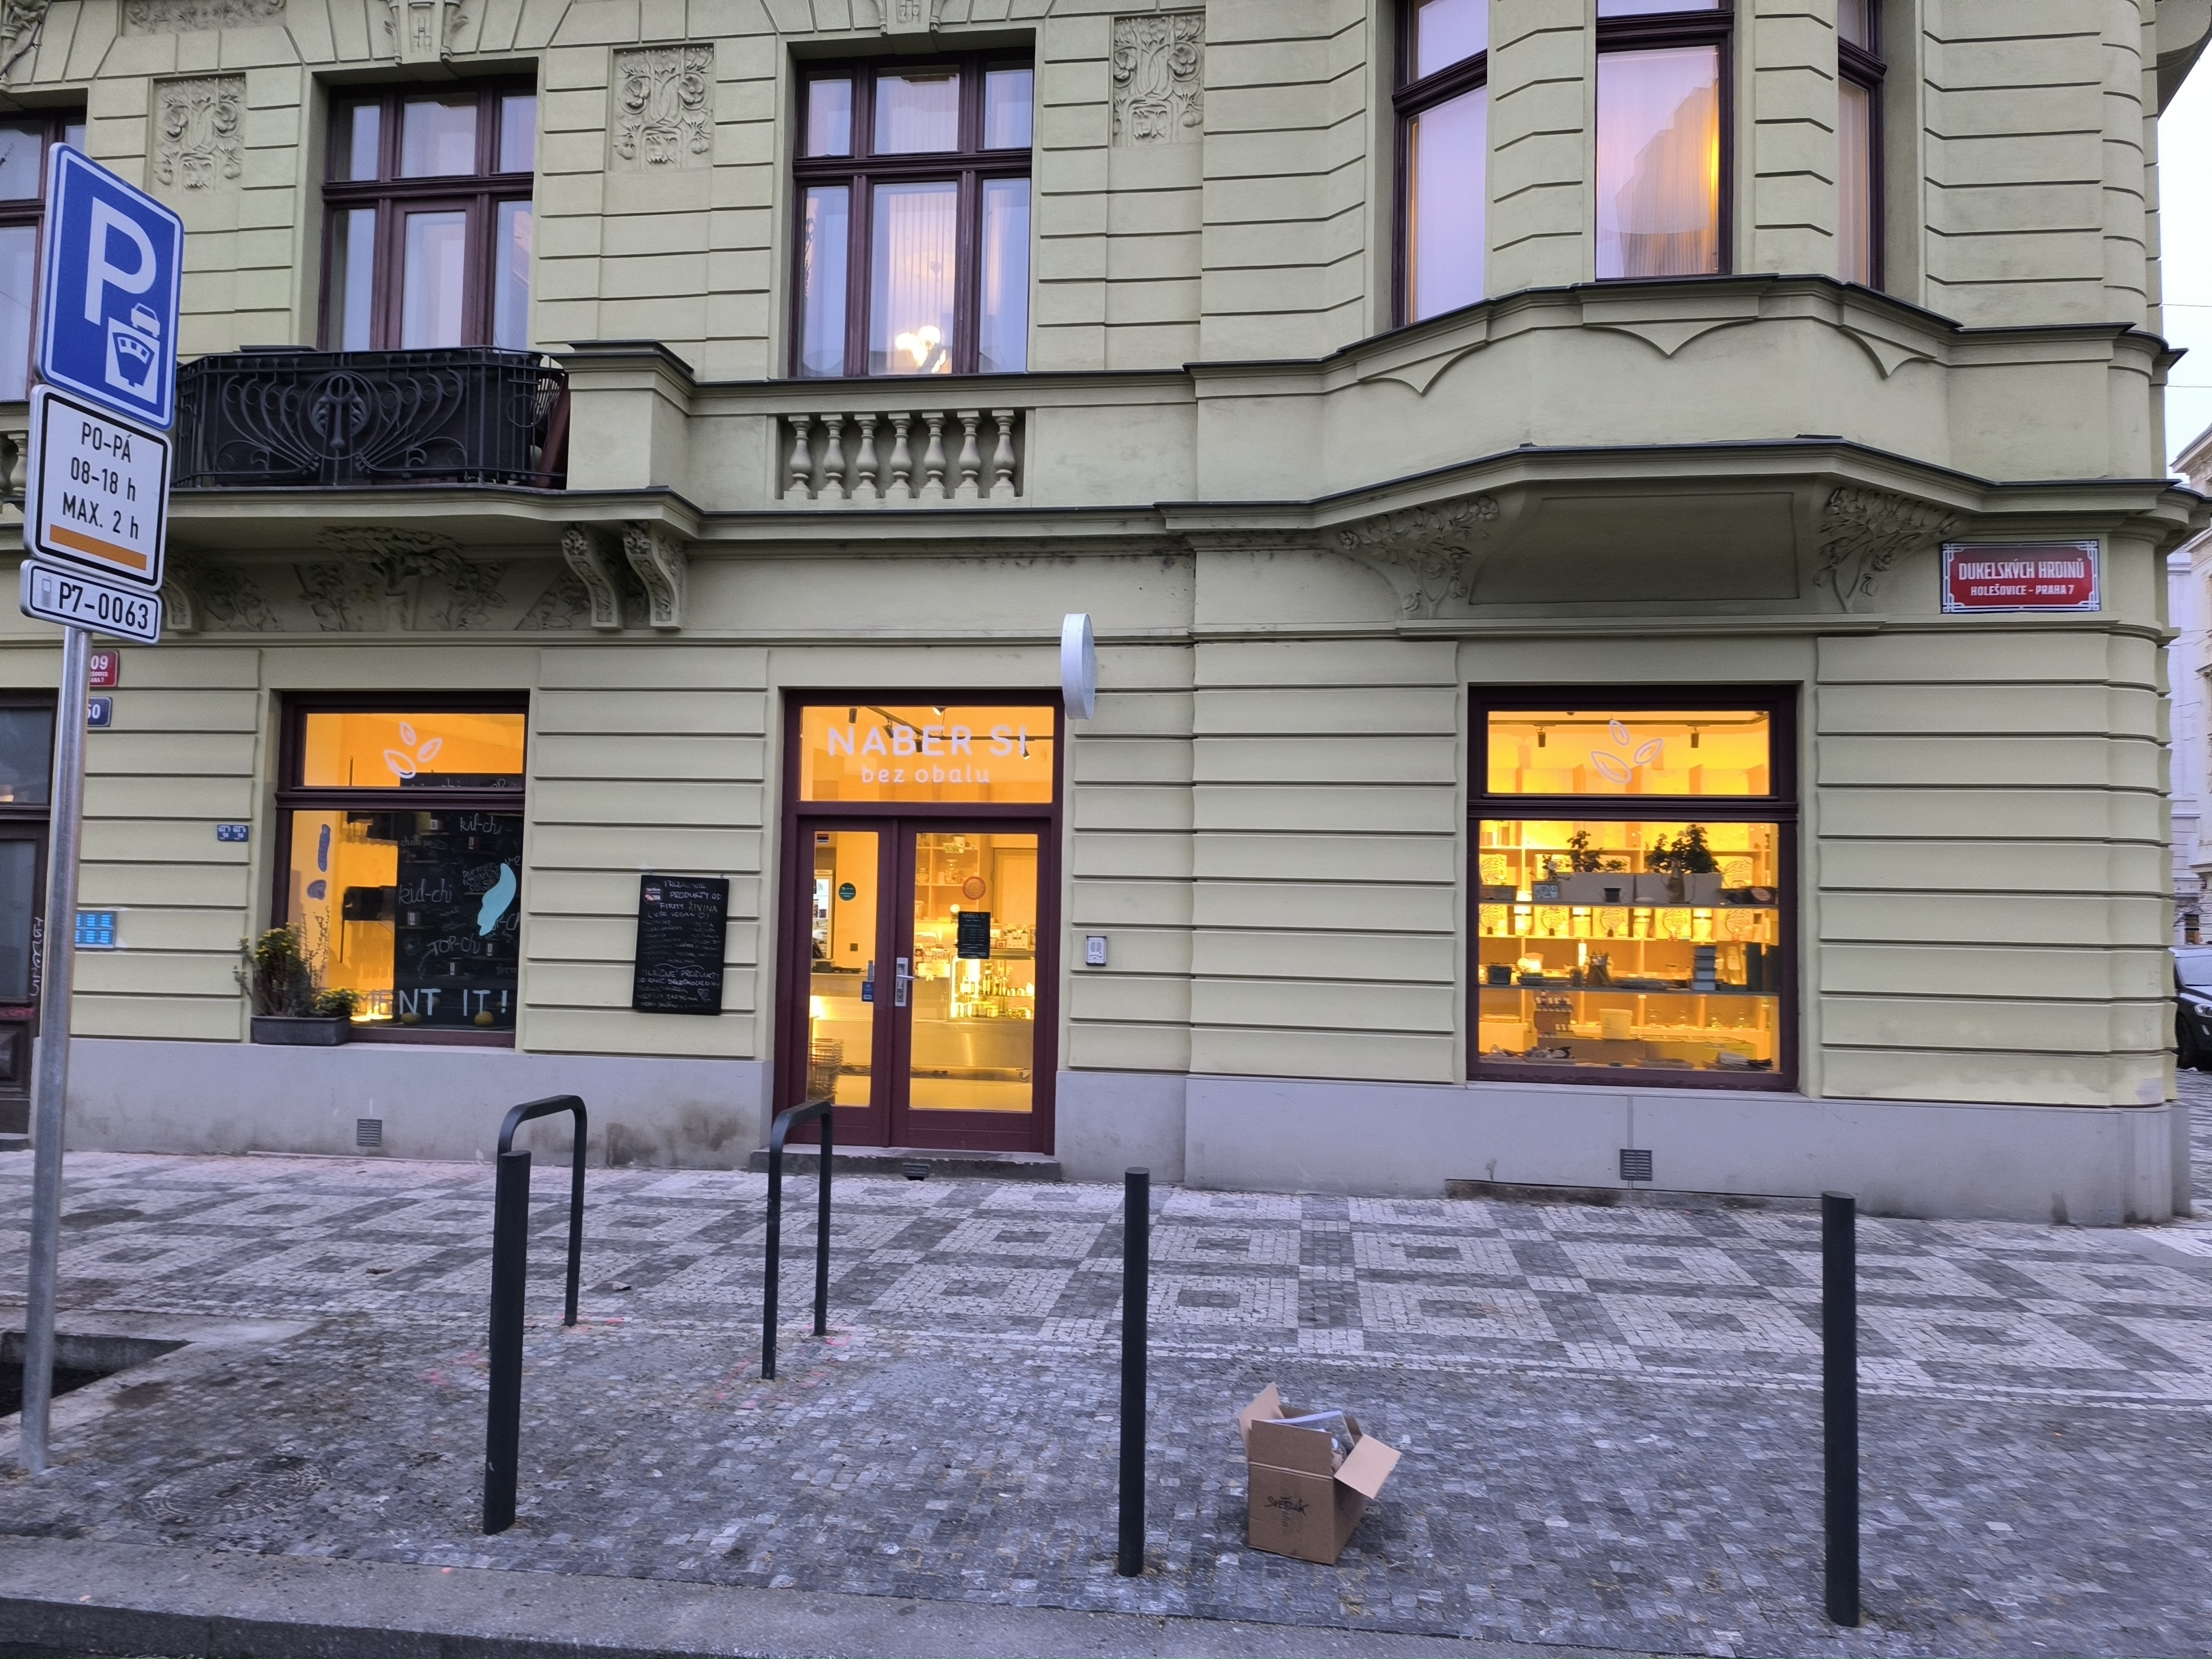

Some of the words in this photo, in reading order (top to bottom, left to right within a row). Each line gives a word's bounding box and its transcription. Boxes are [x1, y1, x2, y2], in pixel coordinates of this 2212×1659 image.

[85, 196, 156, 326] P
[81, 421, 132, 463] PO-PÁ
[71, 456, 118, 494] 08-18
[127, 477, 136, 501] h
[62, 491, 103, 528] MAX.
[113, 510, 121, 534] 2
[130, 516, 138, 539] h
[1959, 558, 2035, 580] DUKELSKÝCH
[2039, 558, 2085, 578] HRDINŮ
[1971, 583, 2027, 596] HOLEŠOVICE
[2035, 585, 2067, 595] PRAHA
[2068, 585, 2074, 594] 7
[59, 581, 149, 630] P7-0063
[828, 725, 972, 756] NABER
[989, 724, 1026, 756] SI
[861, 764, 905, 783] bez
[915, 763, 991, 783] obalu
